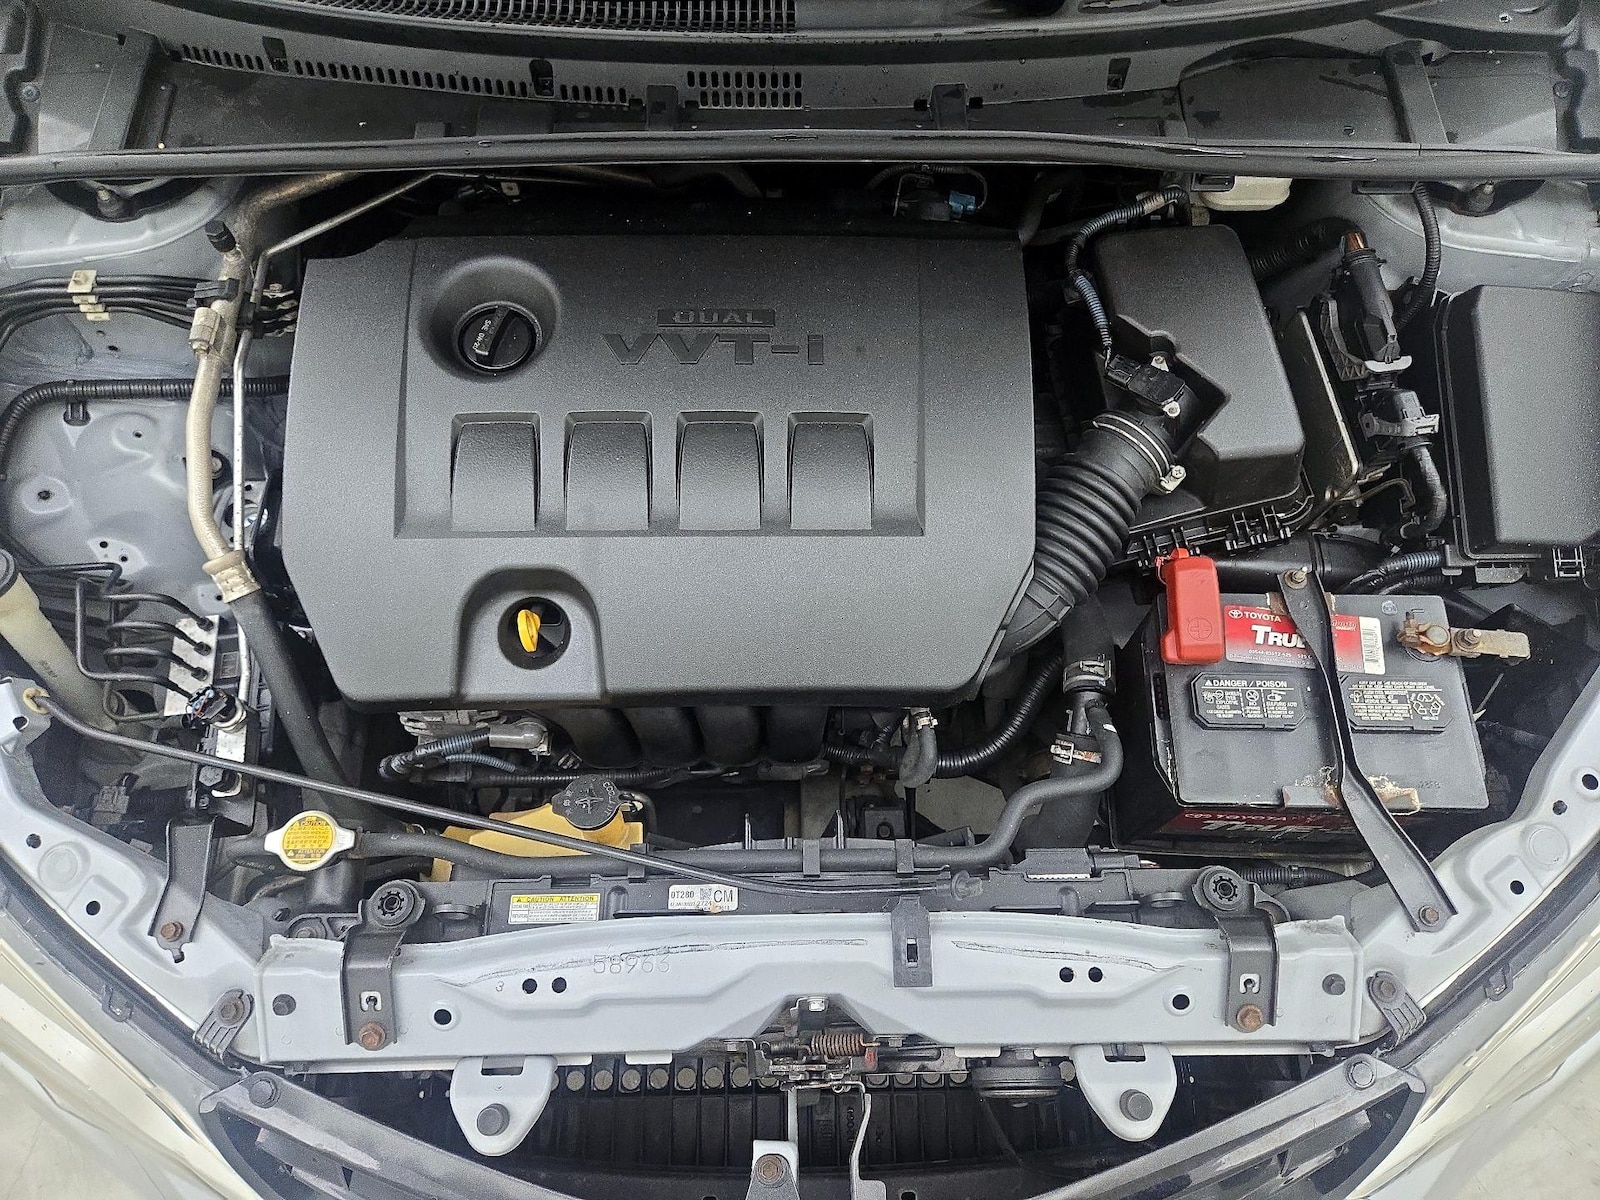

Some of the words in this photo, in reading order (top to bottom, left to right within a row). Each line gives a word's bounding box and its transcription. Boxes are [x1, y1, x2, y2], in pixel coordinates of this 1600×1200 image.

[673, 310, 764, 323] DUAL
[481, 319, 492, 331] SAE
[1244, 610, 1281, 622] TOYOTA
[713, 889, 733, 903] CM
